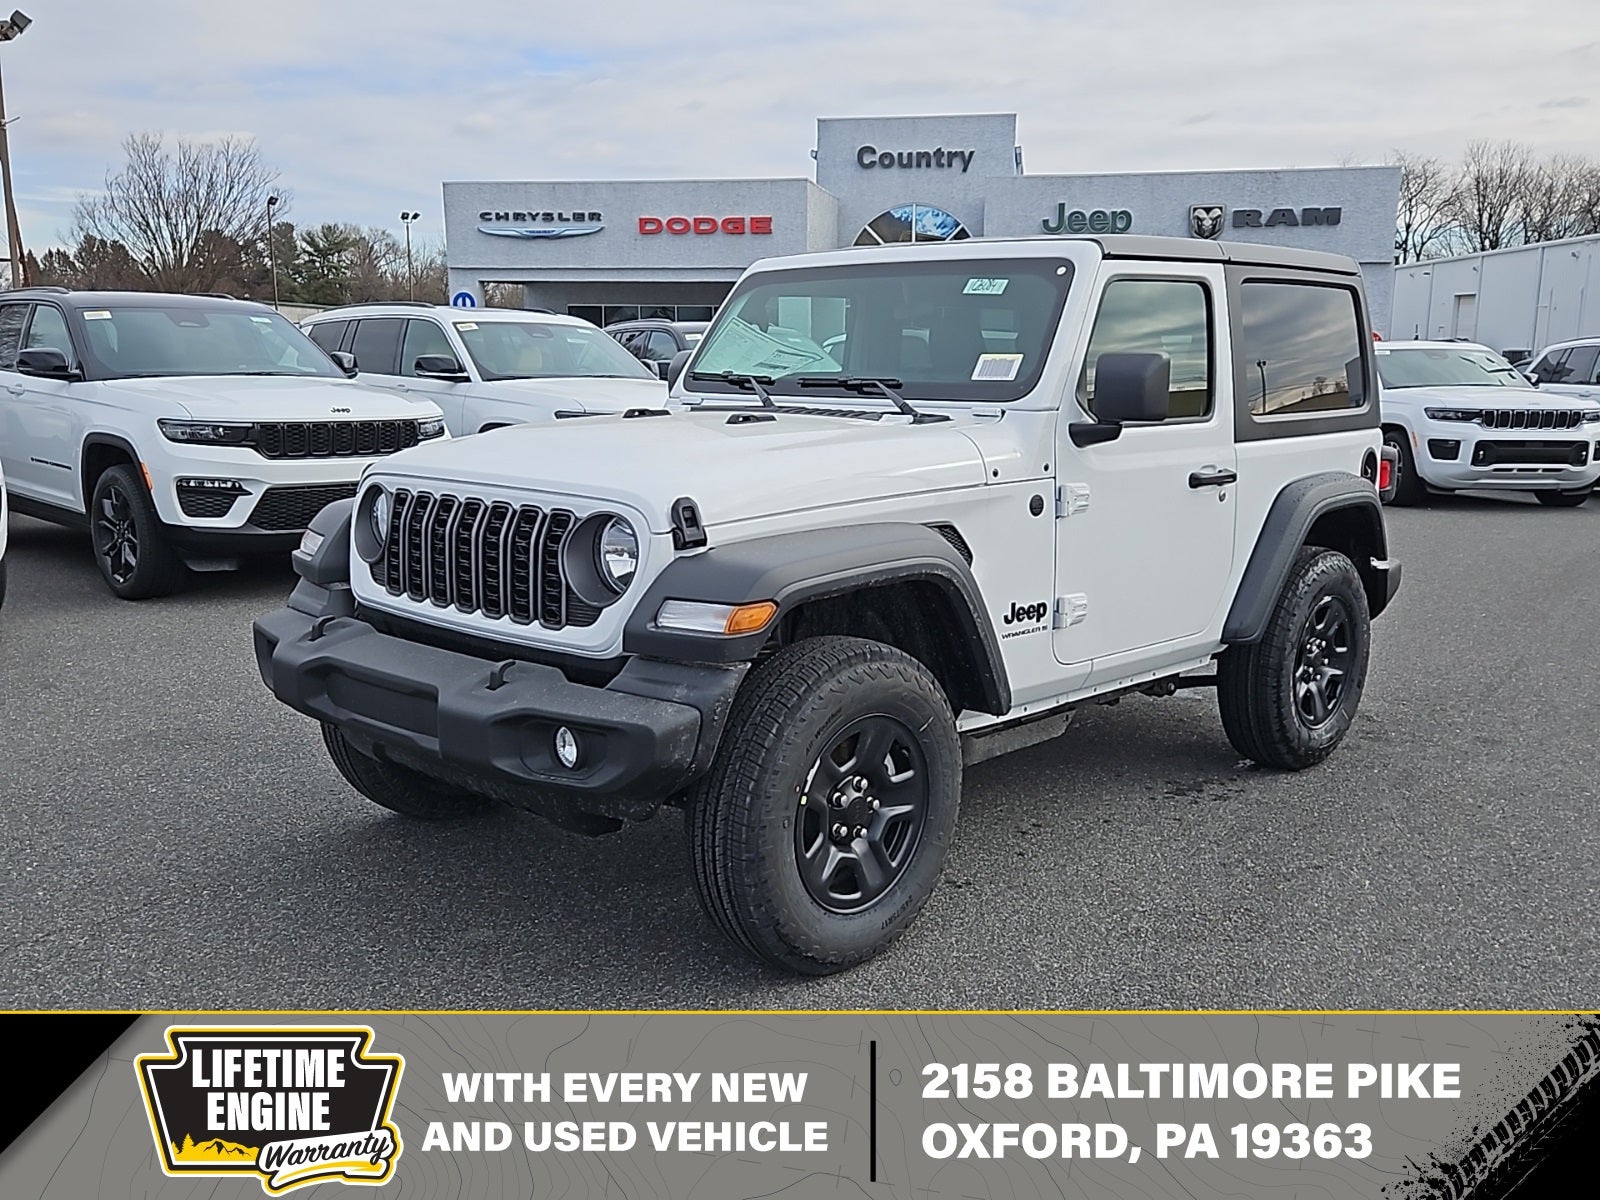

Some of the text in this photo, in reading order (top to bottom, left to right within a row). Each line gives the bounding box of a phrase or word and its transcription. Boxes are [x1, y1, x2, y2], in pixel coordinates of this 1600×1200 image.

[856, 145, 975, 174] Country
[479, 210, 602, 222] CHRYSLER
[638, 216, 773, 235] DODGE
[1042, 202, 1133, 235] Jeep
[1232, 206, 1342, 229] RAM
[1003, 601, 1048, 625] Jeep
[1001, 626, 1041, 640] WRANGLER
